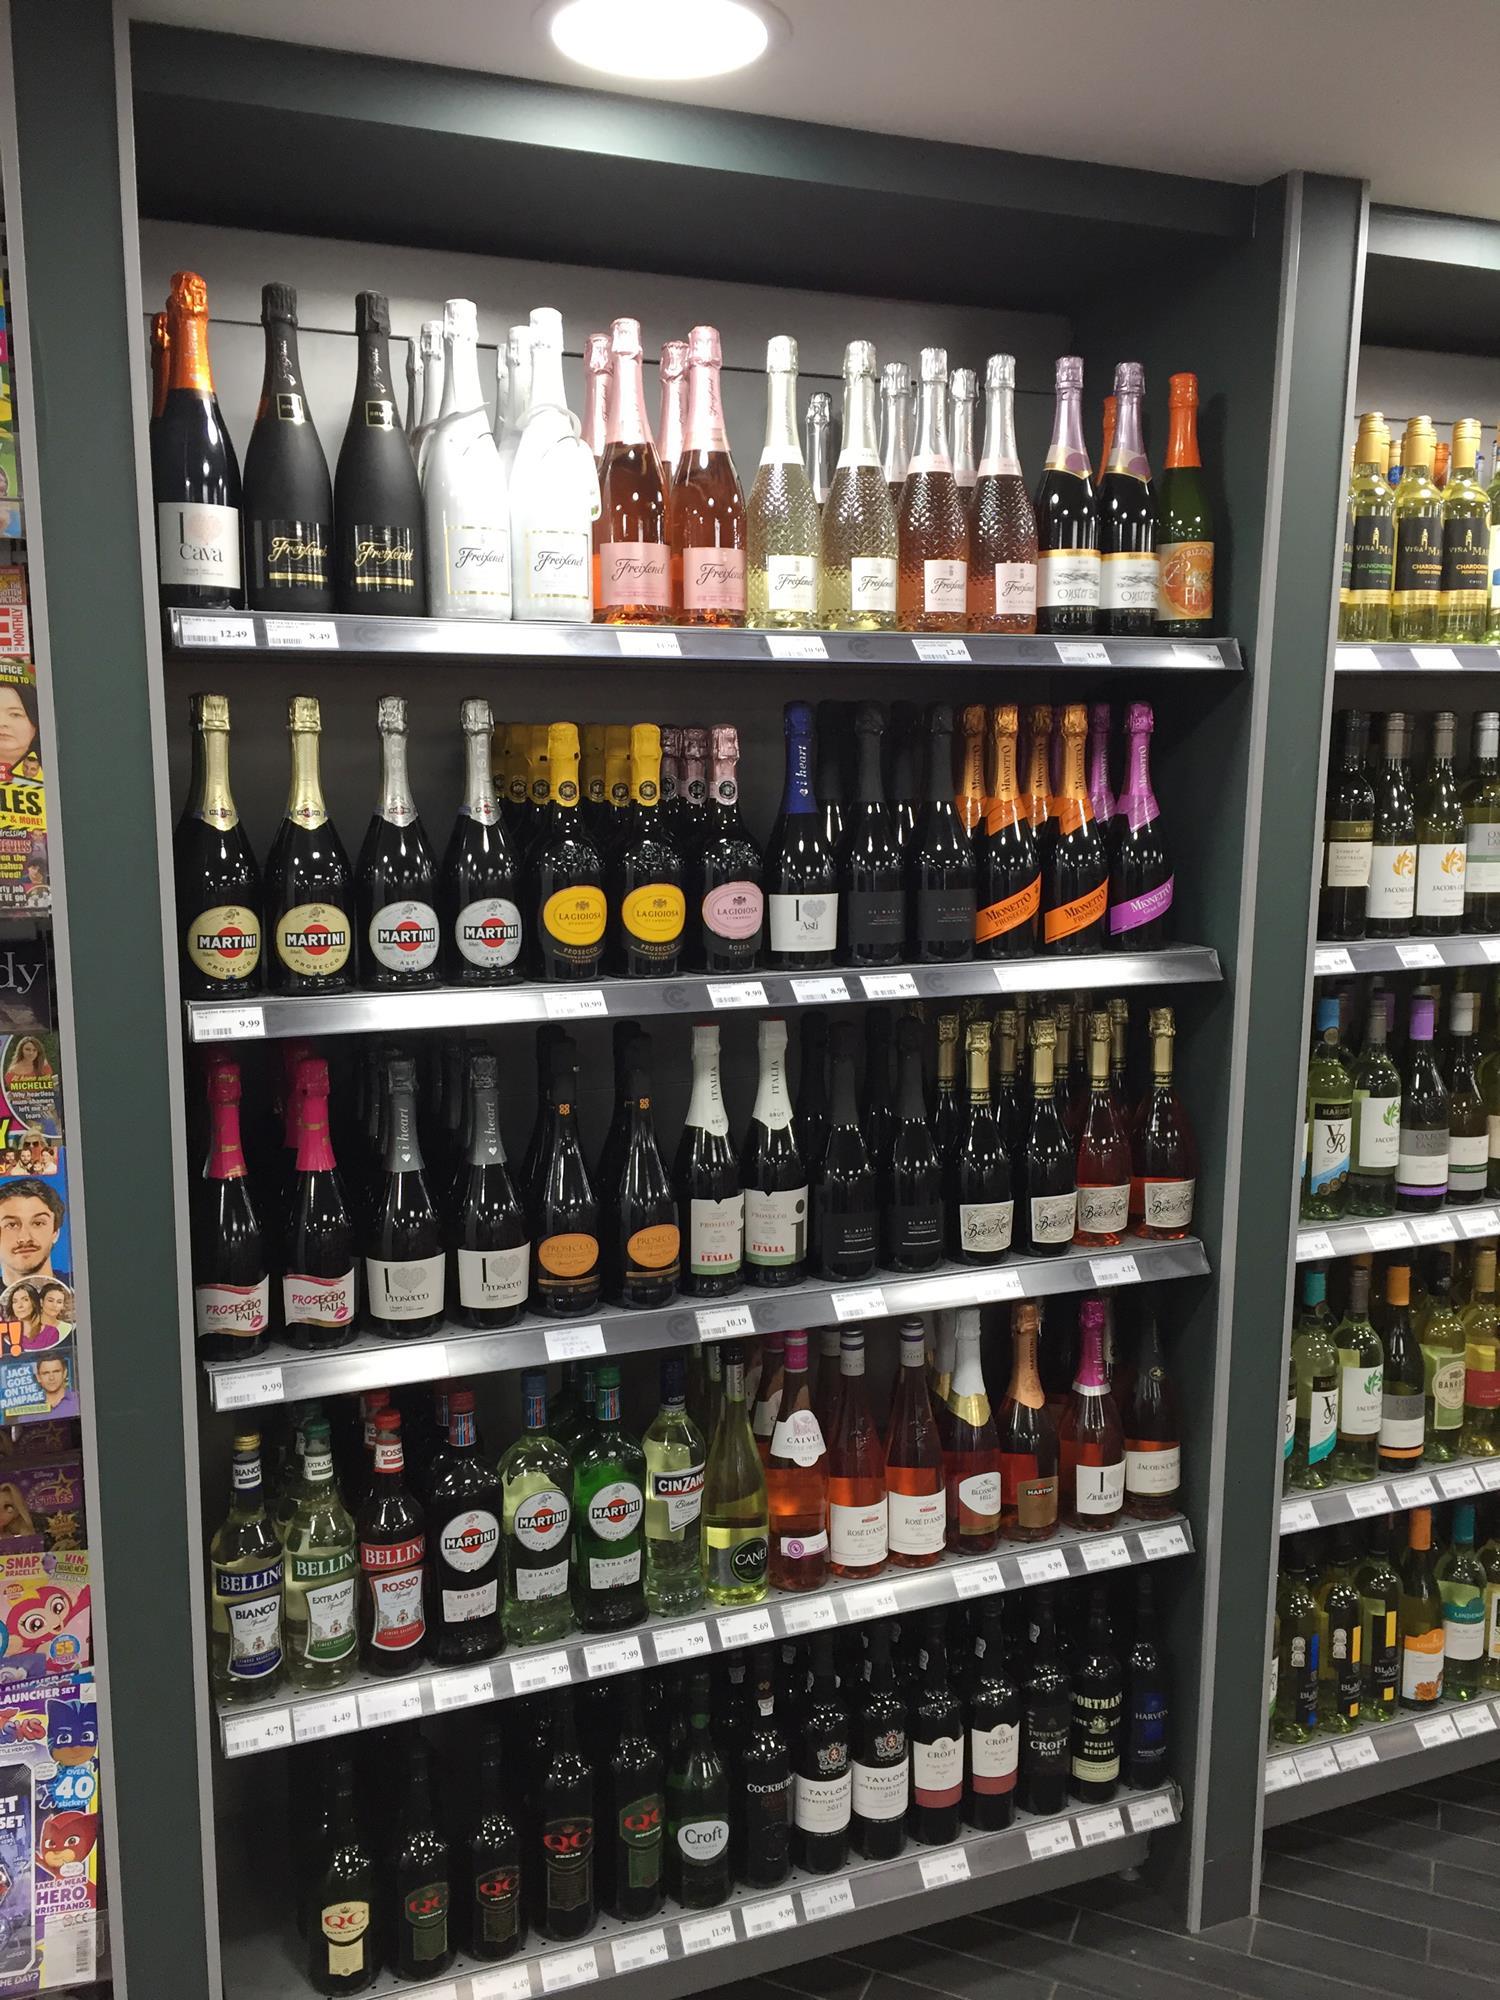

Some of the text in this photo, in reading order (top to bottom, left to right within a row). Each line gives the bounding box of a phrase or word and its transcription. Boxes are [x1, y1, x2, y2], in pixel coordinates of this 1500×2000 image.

[178, 543, 224, 564] Cava
[354, 541, 415, 567] Freixenet
[454, 547, 505, 569] Freixenet
[533, 550, 584, 572] Freixenet
[610, 557, 666, 581] Freixenet
[11, 608, 25, 647] MONTHLY
[219, 629, 248, 639] 12.49
[1001, 743, 1011, 793] MIONETTO
[1073, 744, 1083, 793] MIONETTO
[1138, 744, 1147, 793] MIONETTO
[1063, 889, 1106, 918] MIONETTO
[1130, 883, 1172, 913] MIONETTO
[729, 906, 758, 916] GIOIOSA
[985, 892, 1033, 922] MIONETTO
[648, 910, 680, 918] GIOIOSA
[994, 905, 1030, 928] PROSECCO
[800, 920, 819, 931] Asti
[379, 928, 435, 943] MARTINI
[465, 925, 518, 940] MARTINI
[199, 935, 256, 949] MARTINI
[286, 932, 345, 947] MARTINI
[563, 946, 599, 955] PROSECCO
[640, 943, 676, 951] PROSECCO
[207, 960, 252, 973] PROSECCO
[294, 957, 340, 971] PROSECCO
[744, 989, 763, 997] 9.99
[830, 987, 848, 995] 8.99
[239, 1020, 260, 1029] 9.99
[771, 1059, 780, 1095] ITALIA
[10, 1081, 54, 1090] MICHELLE
[711, 1065, 719, 1102] ITALIA
[397, 1106, 409, 1144] heart
[484, 1101, 496, 1139] heart
[751, 1212, 787, 1220] PROSECCO
[699, 1220, 735, 1229] PROSECCO
[752, 1243, 786, 1253] ITALIA
[700, 1252, 734, 1262] ITALIA
[1121, 1265, 1136, 1273] 4.15
[481, 1278, 523, 1292] Prosecco
[291, 1290, 346, 1306] PROSECCO
[384, 1291, 430, 1303] Prosecco
[205, 1298, 262, 1316] PROSECCO
[725, 1318, 748, 1327] 10.19
[6, 1367, 31, 1379] JACK
[7, 1377, 33, 1388] GOES
[261, 1382, 283, 1393] 9.99
[4, 1384, 38, 1398] ON THE
[1027, 1486, 1054, 1496] MARTINI
[593, 1500, 640, 1518] MARTINI
[519, 1511, 567, 1529] MARTINI
[446, 1530, 496, 1549] MARTINI
[1111, 1548, 1126, 1557] 9.49
[6, 1555, 40, 1569] SNAP
[65, 1553, 86, 1565] WIN
[594, 1556, 638, 1569] EXTRA DRY
[5, 1568, 40, 1577] BRACELET
[527, 1568, 561, 1579] BIANCO
[982, 1574, 998, 1583] 9.99
[381, 1576, 419, 1593] ROSSO
[312, 1586, 352, 1605] EXTRA DRY
[456, 1589, 488, 1600] ROSSO
[235, 1601, 278, 1620] BIANCO
[752, 1622, 769, 1632] 5.69
[687, 1636, 704, 1645] 7.99
[55, 1641, 74, 1655] 55
[621, 1650, 639, 1661] 7.99
[551, 1664, 569, 1675] 7.99
[61, 1686, 76, 1695] SET
[473, 1681, 492, 1693] 8.49
[401, 1697, 420, 1708] 4.79
[332, 1712, 352, 1724] 4.49
[264, 1725, 285, 1737] 4.79
[985, 1735, 1014, 1746] CROFT
[1030, 1737, 1068, 1750] CROFT
[1084, 1740, 1115, 1748] SPECIAL
[927, 1748, 957, 1759] CROFT
[1040, 1749, 1061, 1757] PORT
[1083, 1748, 1115, 1756] RESERVE
[55, 1776, 94, 1799] 40
[56, 1799, 89, 1808] stickers
[1152, 1807, 1169, 1817] 11.99
[1108, 1820, 1122, 1831] 5.99
[684, 1825, 723, 1845] Croft
[951, 1863, 966, 1873] 7.99
[64, 1876, 88, 1887] WEAR
[35, 1886, 86, 1906] HERO
[828, 1893, 848, 1905] 13.99
[778, 1908, 795, 1920] 9.99
[711, 1925, 732, 1937] 11.99
[577, 1962, 594, 1974] 6.99
[512, 1978, 530, 1991] 4.49
